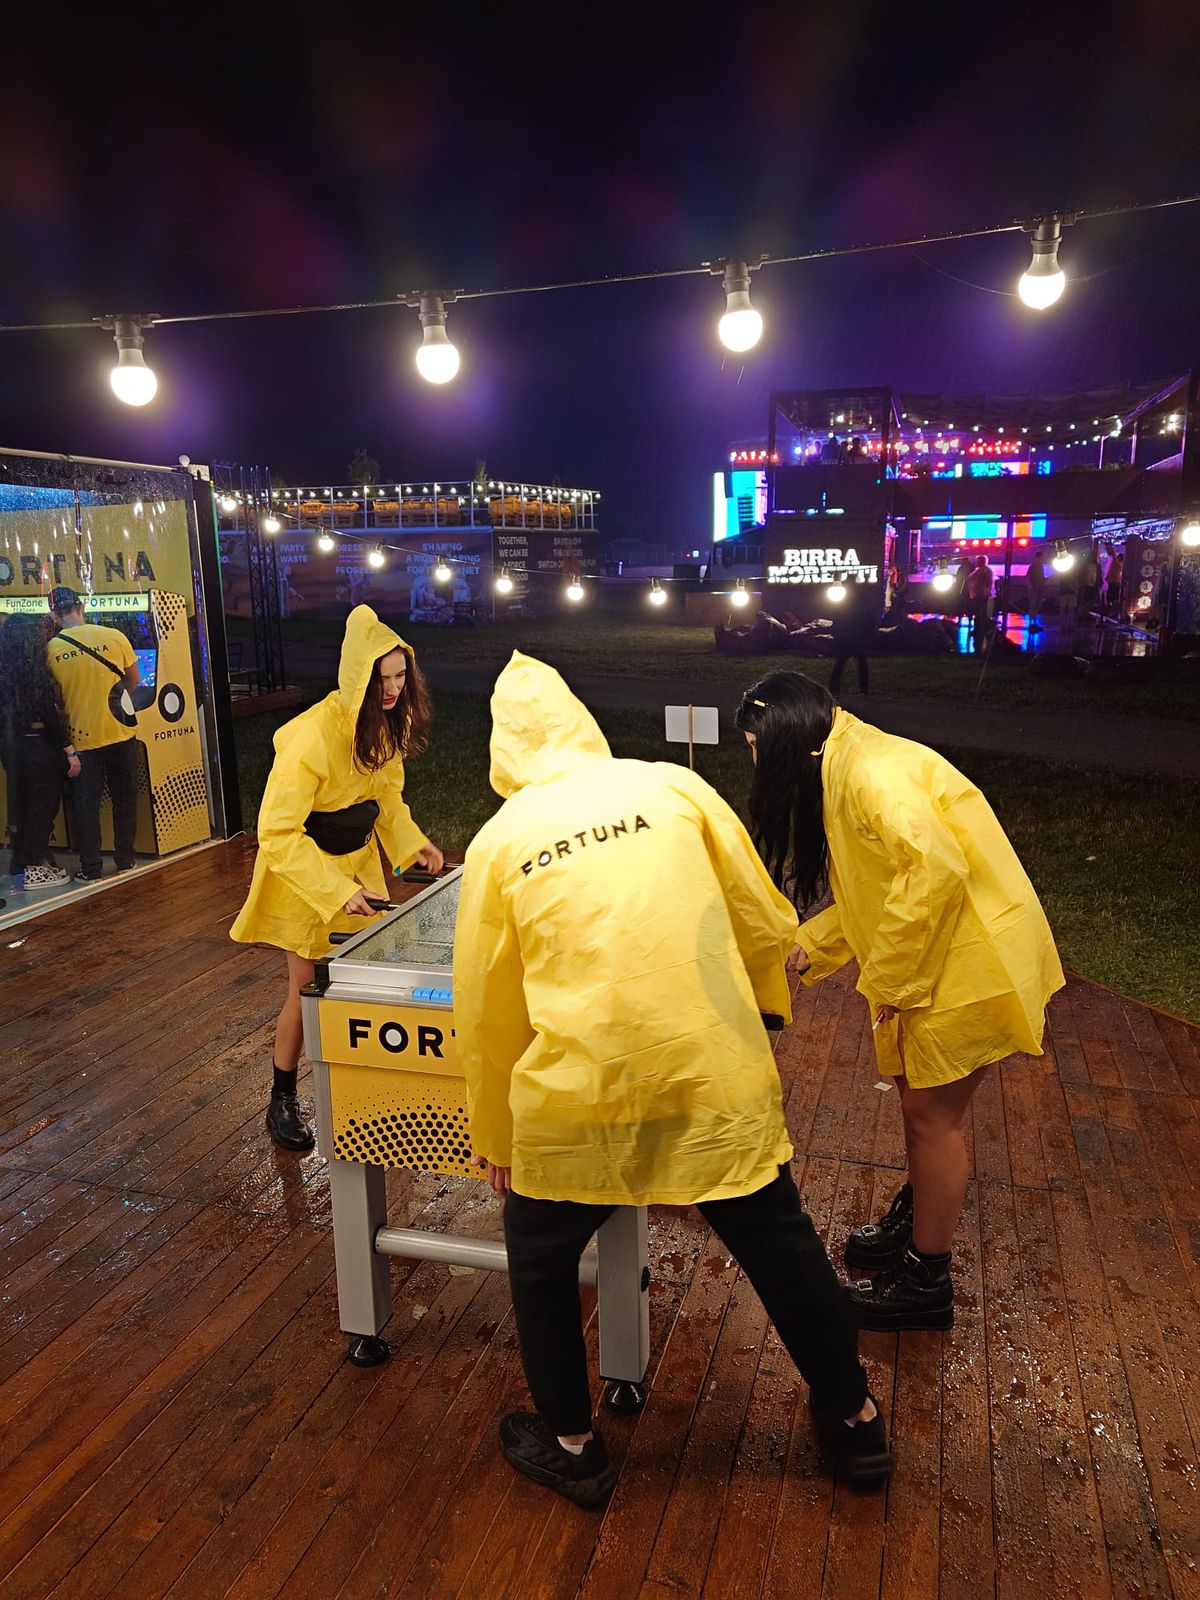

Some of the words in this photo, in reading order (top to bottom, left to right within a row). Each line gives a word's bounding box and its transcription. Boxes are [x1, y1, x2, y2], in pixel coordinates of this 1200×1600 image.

[422, 543, 463, 551] SHARING
[498, 536, 528, 546] TOGETHER,
[279, 543, 305, 552] PARTY
[279, 555, 308, 563] WASTE
[783, 548, 860, 566] BIRRA
[768, 565, 879, 583] MORETTI
[6, 599, 43, 608] FunZone
[84, 597, 139, 607] FORTUNA
[55, 644, 109, 663] FORTNA
[154, 726, 195, 741] FORTUNA
[520, 814, 651, 877] FORTUNA
[348, 1018, 455, 1058] FOR
